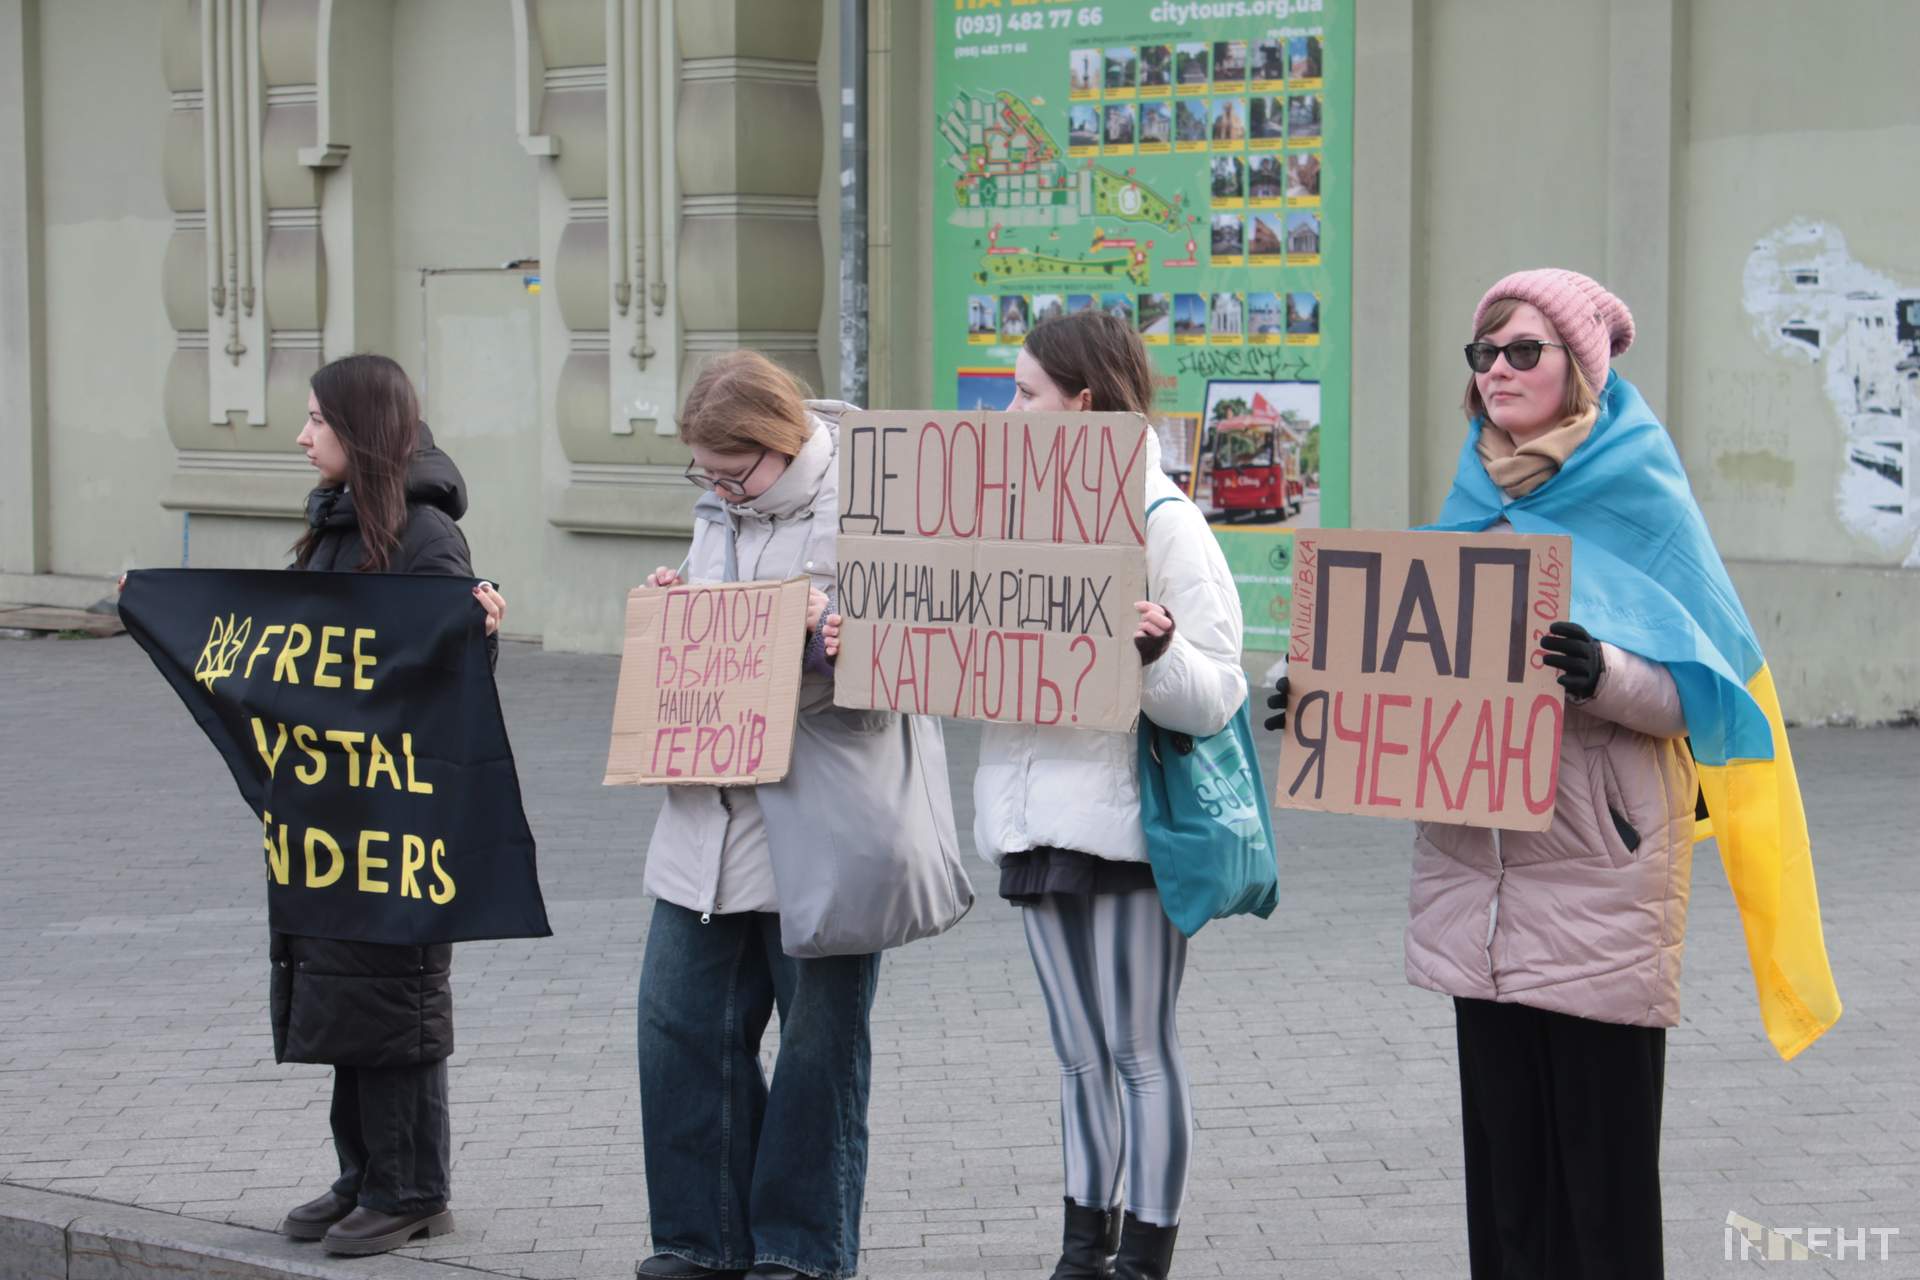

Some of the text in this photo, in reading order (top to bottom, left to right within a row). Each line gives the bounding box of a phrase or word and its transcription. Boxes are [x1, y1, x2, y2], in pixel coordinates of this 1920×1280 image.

[955, 7, 1103, 39] (093) 482 77 66
[1150, 0, 1322, 25] citytours.org.ua
[839, 427, 907, 535] ДЕ
[916, 421, 1008, 539] ООН
[1019, 423, 1148, 546] МКЧХ
[662, 588, 773, 643] ПОЛОН
[837, 560, 899, 620] КОЛИ
[903, 563, 993, 626] НАШИХ
[1311, 546, 1532, 683] ПАП
[244, 623, 378, 690] FREE
[656, 642, 767, 689] ВБИВАЄ
[870, 623, 1097, 725] КАТУЮТЬ?
[657, 689, 725, 725] НАШИХ
[651, 708, 767, 777] ГЕРОЇВ
[1288, 689, 1564, 815] Я ЧЕКАЮ
